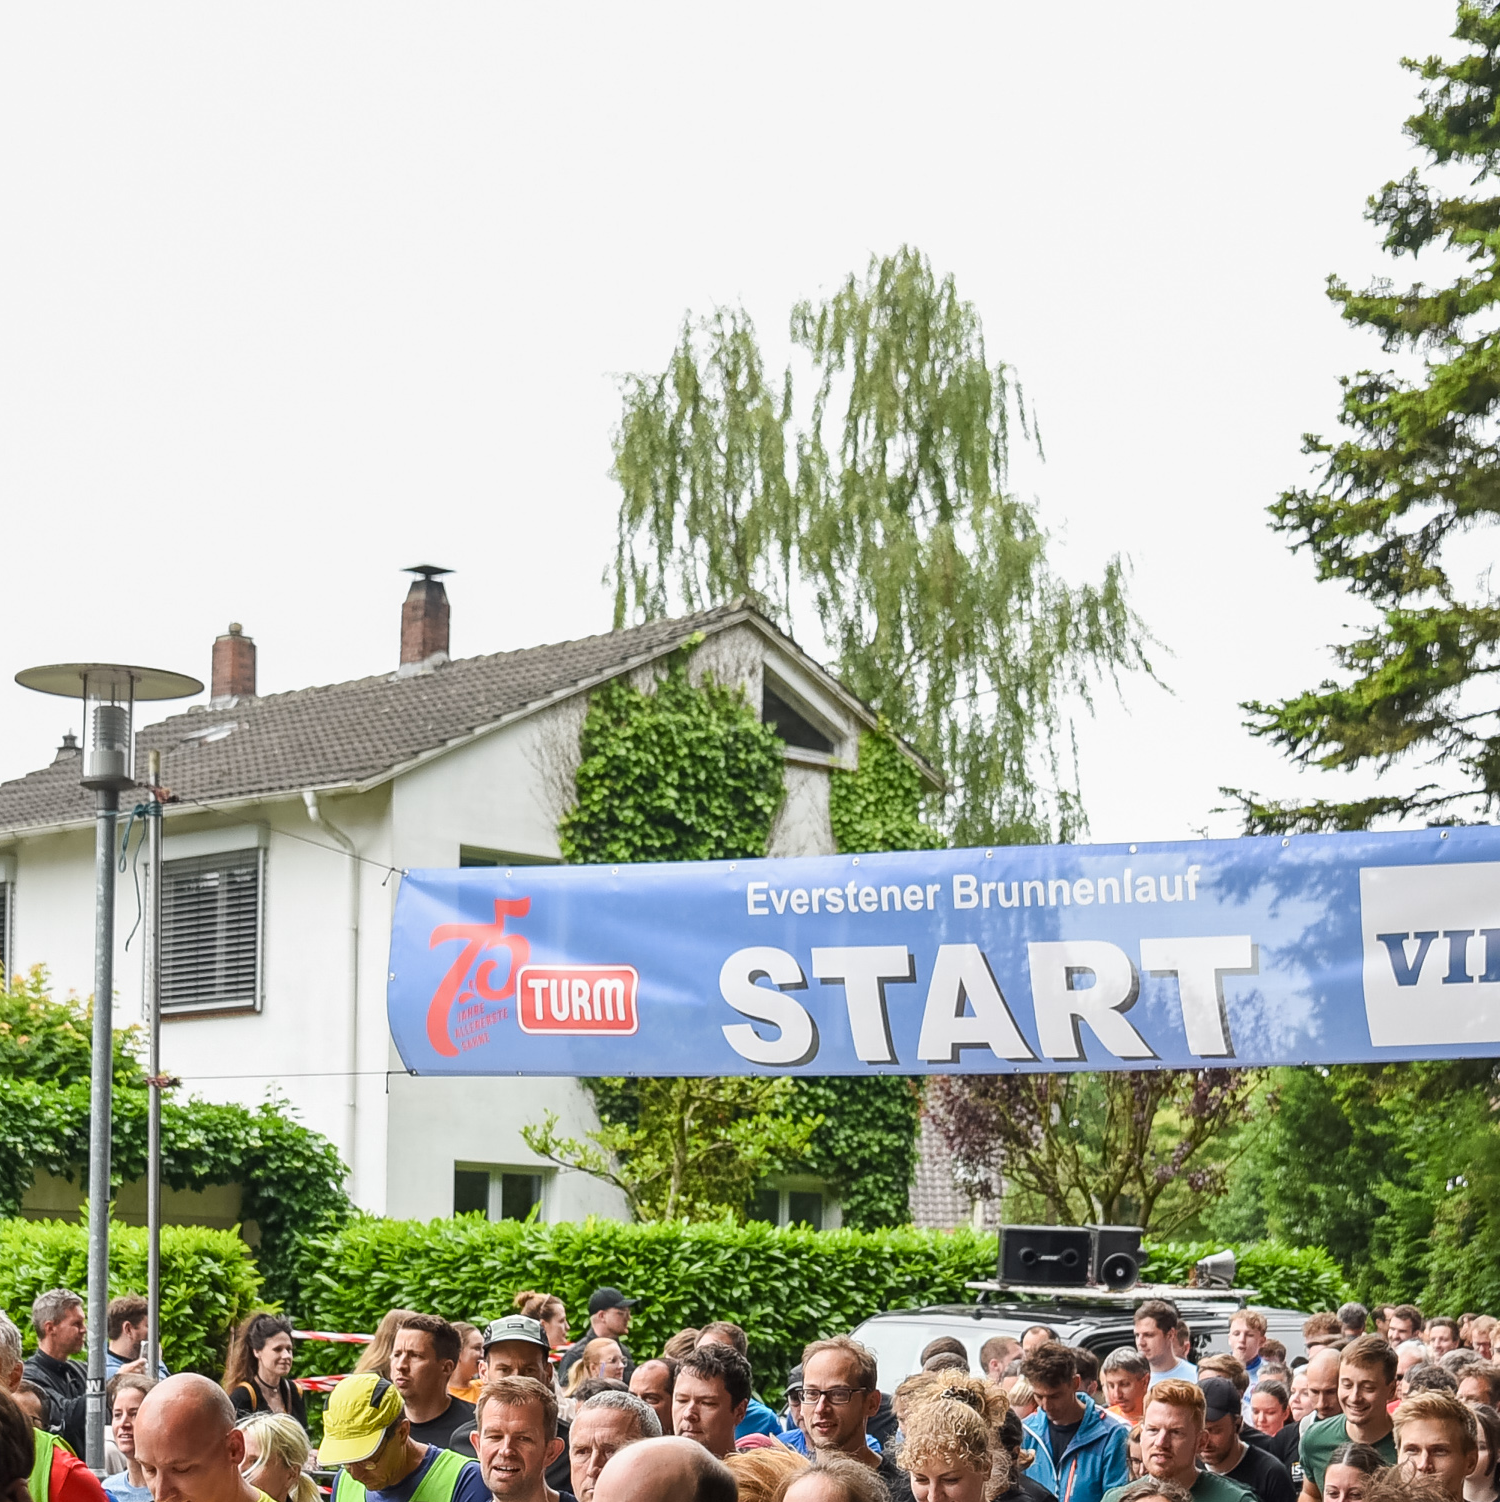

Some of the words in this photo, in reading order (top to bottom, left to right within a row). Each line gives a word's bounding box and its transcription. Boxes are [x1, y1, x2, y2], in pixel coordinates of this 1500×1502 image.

[747, 879, 941, 916] Everstener
[953, 865, 1200, 909] Brunnenlauf
[426, 895, 532, 1058] 75
[528, 978, 626, 1022] TURM
[719, 935, 1259, 1066] START
